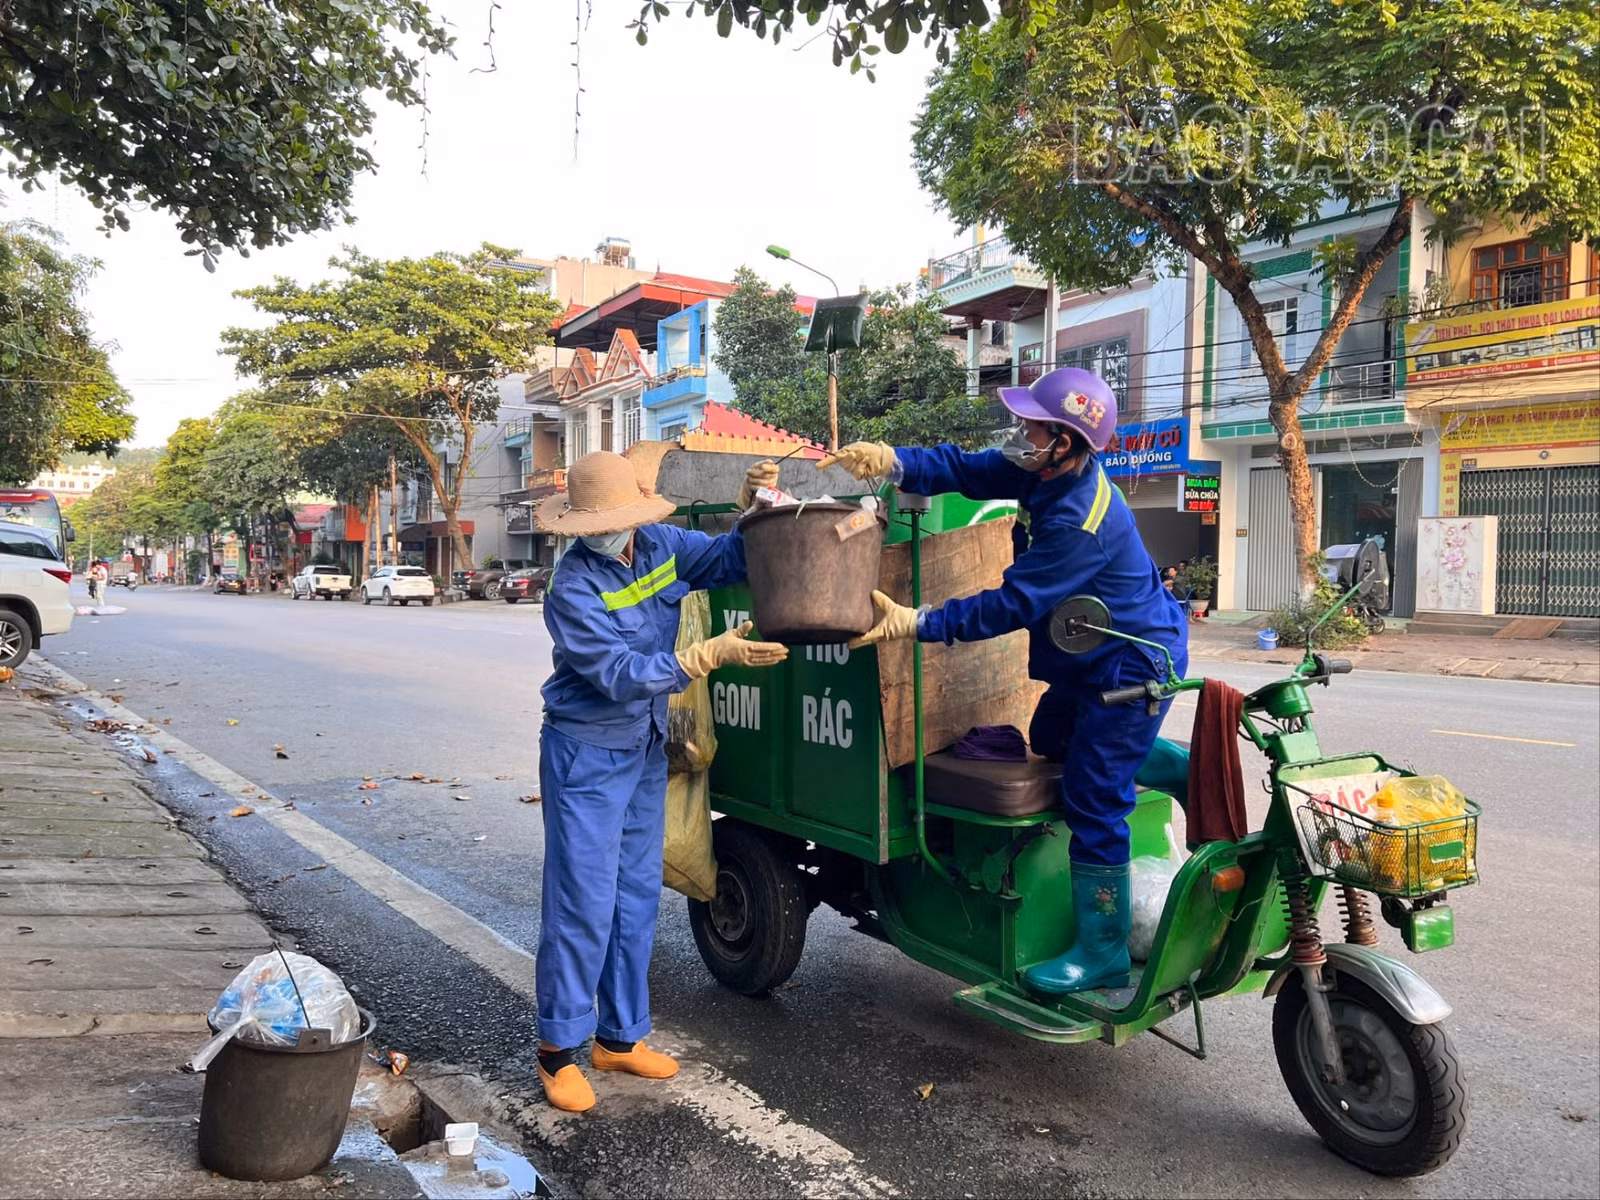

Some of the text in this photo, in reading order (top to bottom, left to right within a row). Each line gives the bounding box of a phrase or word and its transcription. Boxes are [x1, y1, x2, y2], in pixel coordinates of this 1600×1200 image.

[1105, 450, 1172, 467] BẢO DƯỠNG
[1185, 489, 1218, 499] SỬA CHỮA
[713, 681, 761, 731] GOM
[802, 687, 853, 749] RÁC
